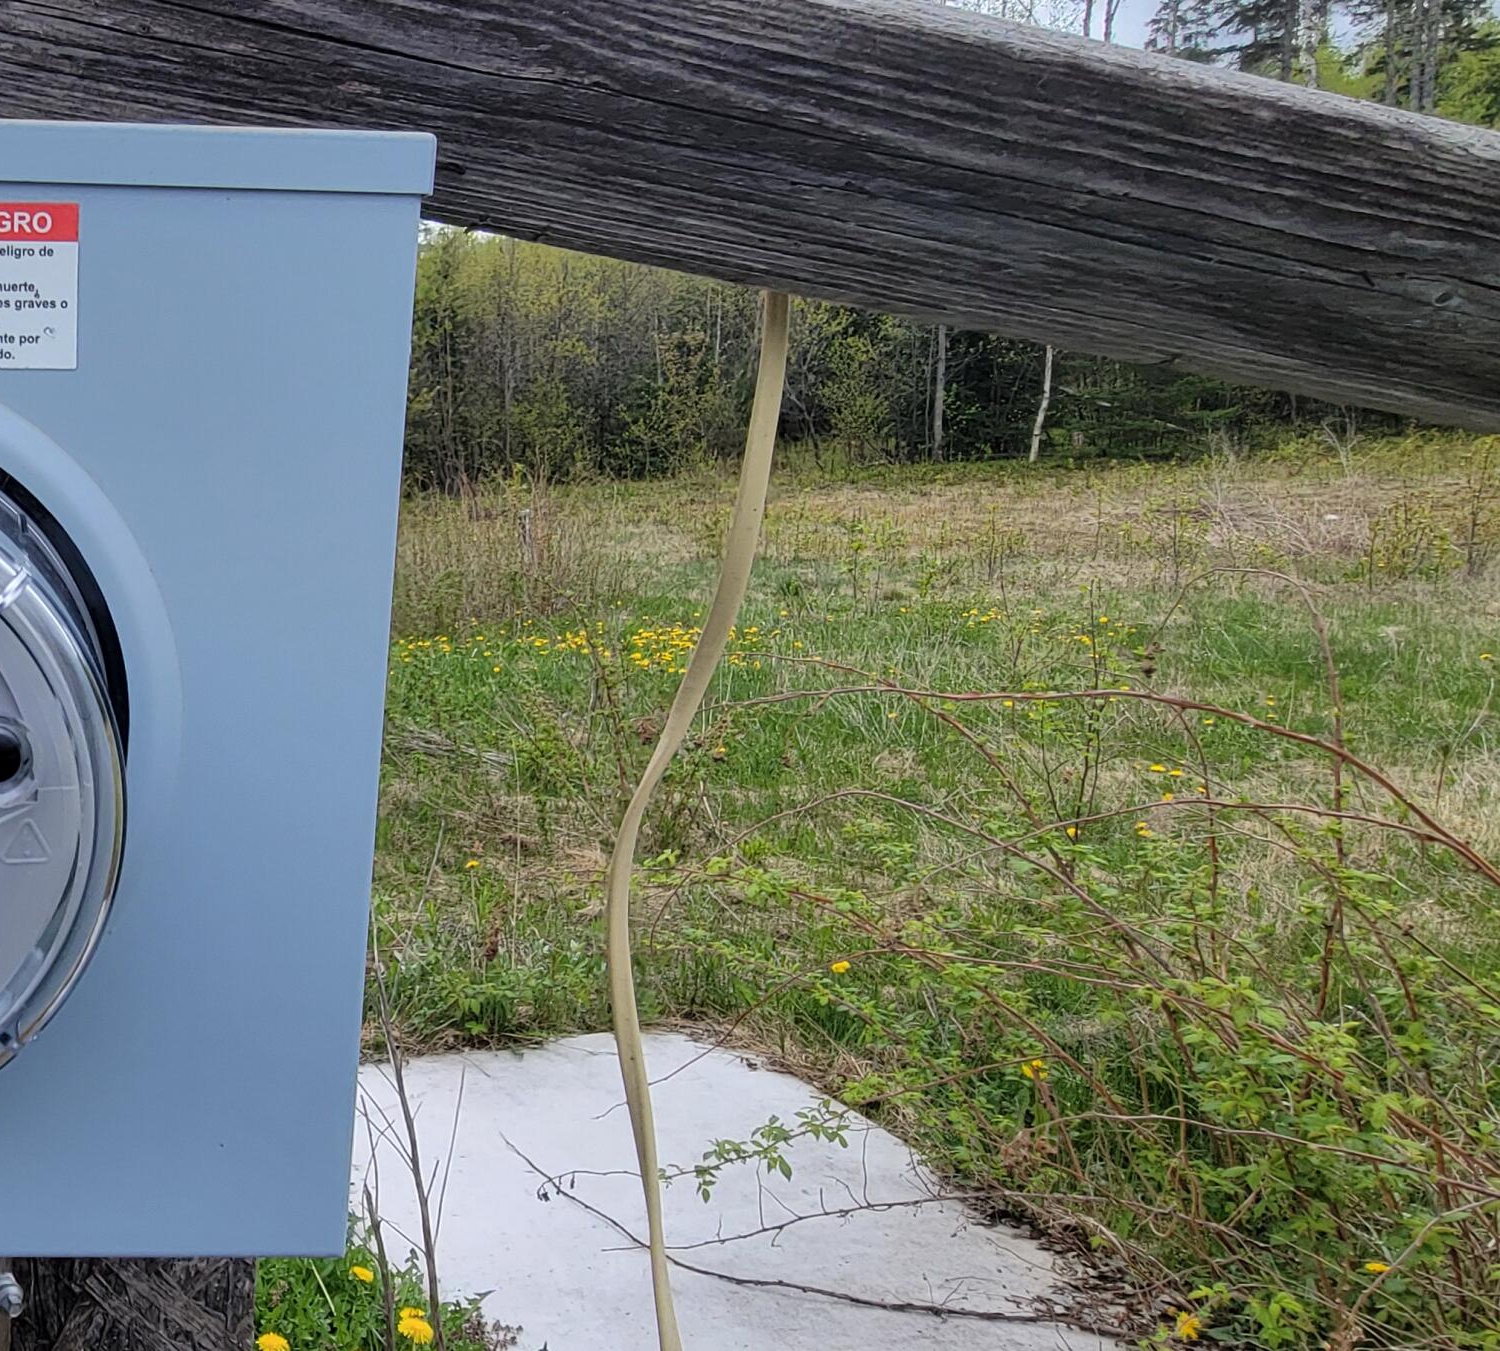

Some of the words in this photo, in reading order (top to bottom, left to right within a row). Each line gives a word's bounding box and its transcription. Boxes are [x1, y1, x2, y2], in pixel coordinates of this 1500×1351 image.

[38, 246, 54, 257] de
[14, 299, 57, 311] graves
[60, 301, 68, 309] o
[19, 335, 40, 347] por
